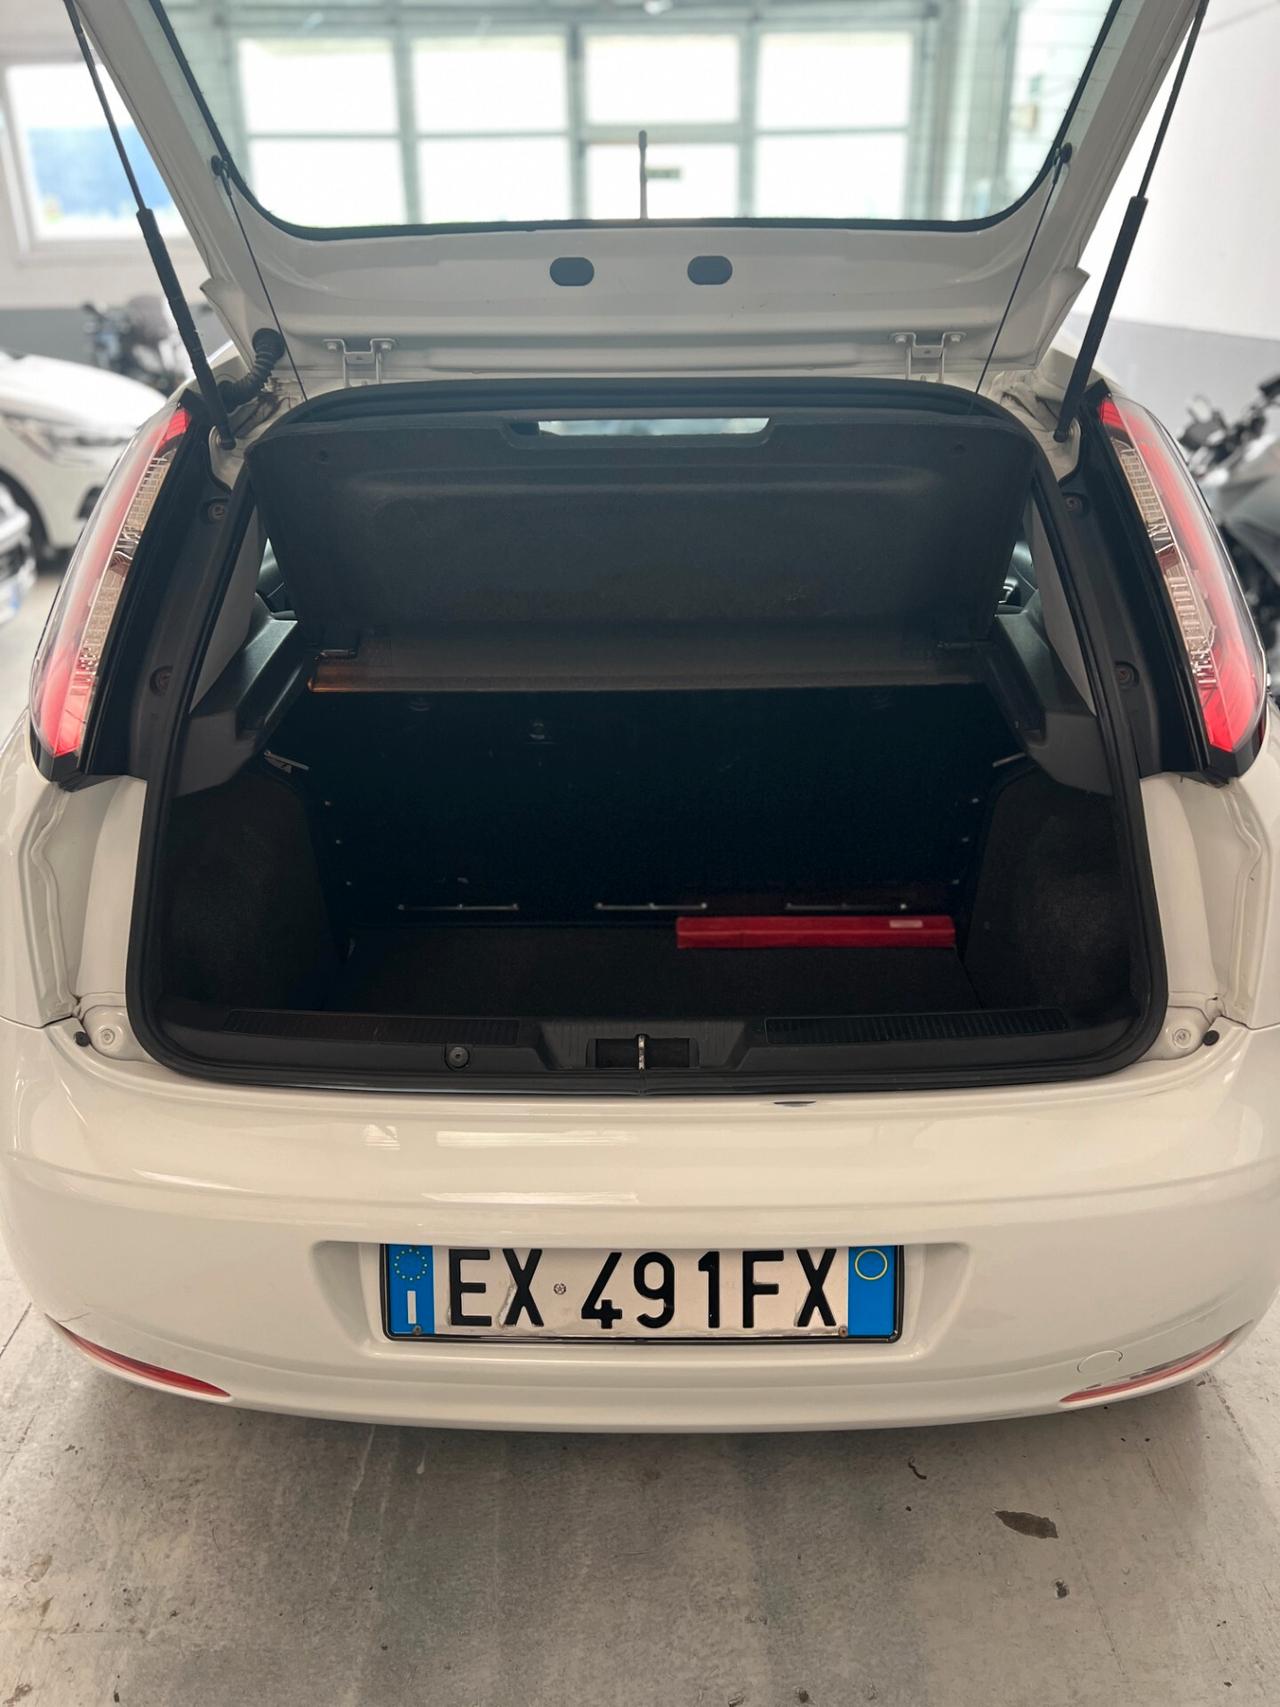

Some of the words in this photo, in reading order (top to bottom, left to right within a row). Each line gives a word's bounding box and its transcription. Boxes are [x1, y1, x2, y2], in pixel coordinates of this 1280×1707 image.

[406, 1290, 416, 1324] I
[448, 1248, 544, 1327] EX
[580, 1249, 837, 1329] 491FX
